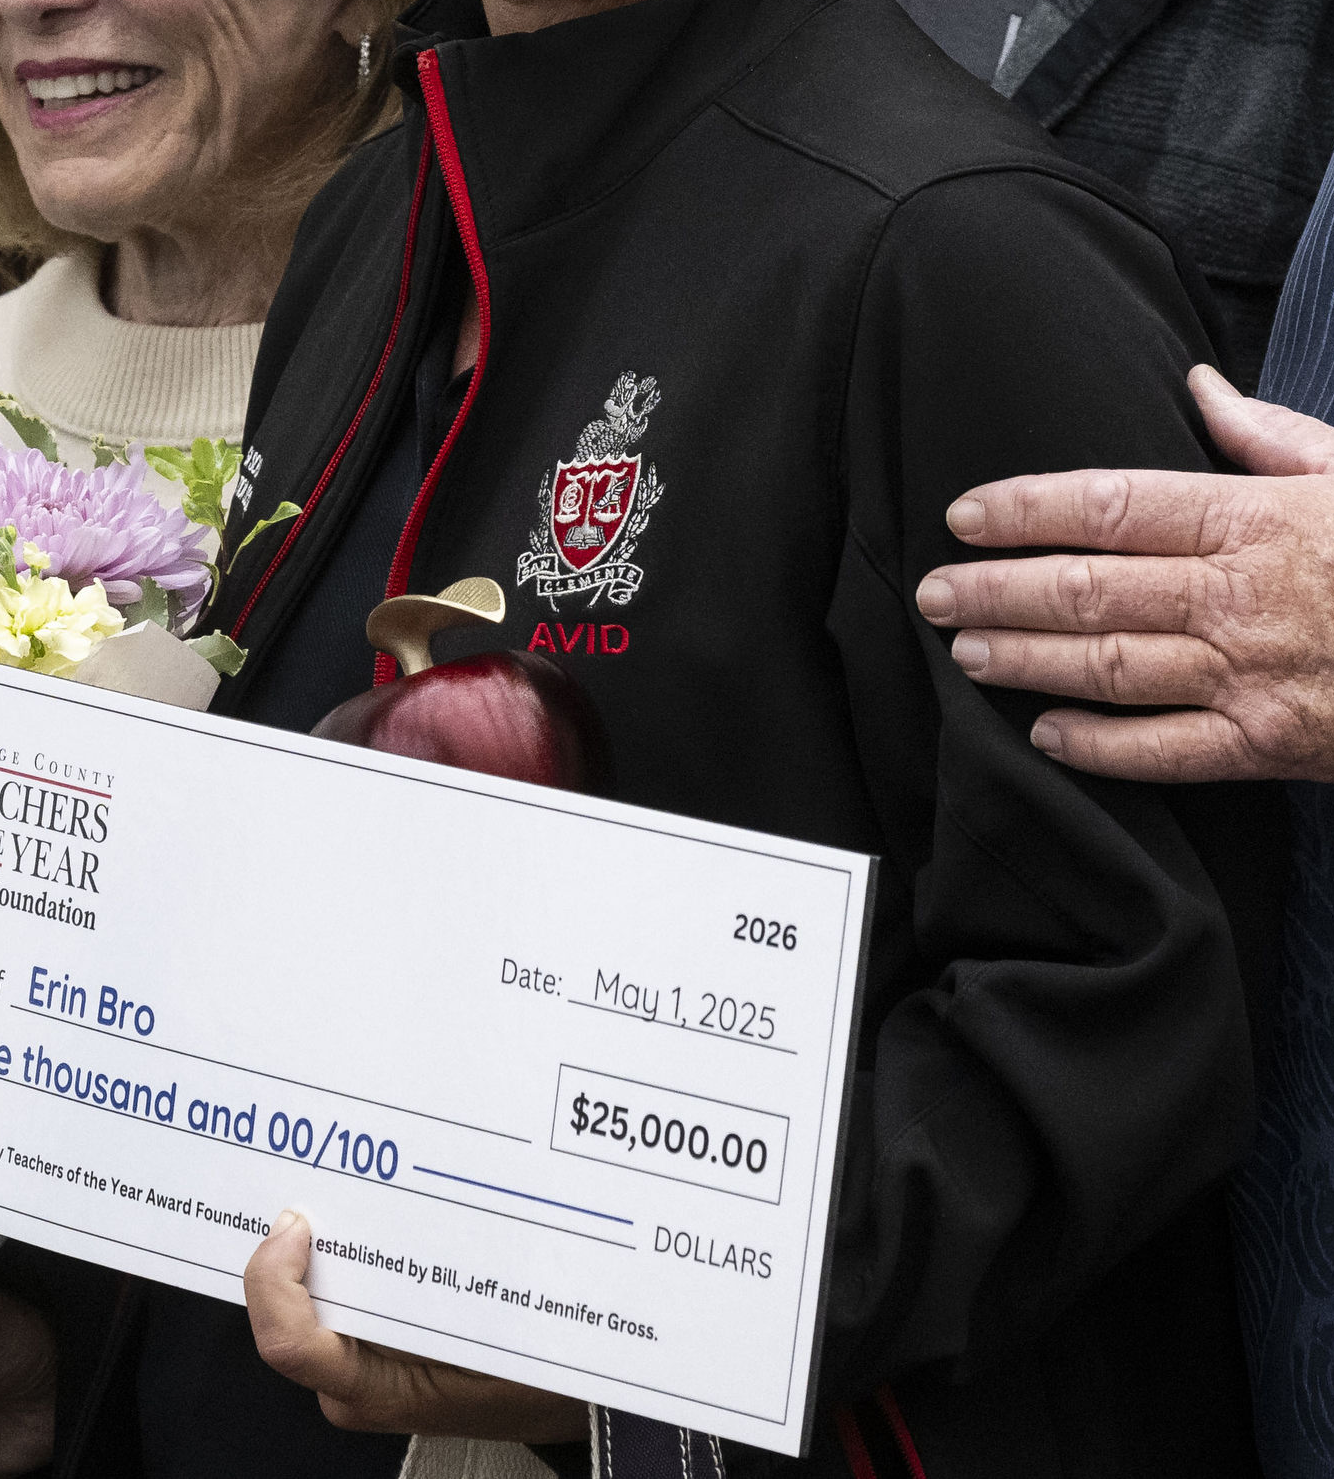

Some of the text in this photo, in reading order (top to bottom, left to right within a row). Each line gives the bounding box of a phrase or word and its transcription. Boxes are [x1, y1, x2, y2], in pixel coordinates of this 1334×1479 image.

[521, 558, 552, 581] SAN
[542, 566, 638, 593] CLEMENTE
[526, 622, 631, 655] AVID
[33, 751, 116, 790] COUNTY
[10, 831, 101, 895] YEAR
[732, 912, 799, 952] 2026
[27, 965, 88, 1020] Erin
[96, 984, 156, 1037] Bro
[500, 957, 777, 1041] Date: May 1, 2025
[22, 1044, 178, 1123] thousand
[187, 1098, 257, 1144] and
[267, 1111, 399, 1181] 00/100
[569, 1091, 769, 1174] $25,000.00
[6, 1146, 64, 1180] Teachers
[66, 1166, 82, 1185] of
[83, 1169, 108, 1193] the
[110, 1177, 144, 1203] Year
[145, 1187, 192, 1216] Award
[195, 1200, 271, 1238] Foundatio
[315, 1235, 405, 1274] established
[408, 1258, 428, 1285] by
[431, 1266, 462, 1294] Bill,
[464, 1275, 499, 1301] Jeff
[500, 1286, 532, 1309] and
[533, 1294, 604, 1328] Jennifer
[606, 1312, 660, 1343] Gross.
[653, 1225, 774, 1280] DOLLARS
